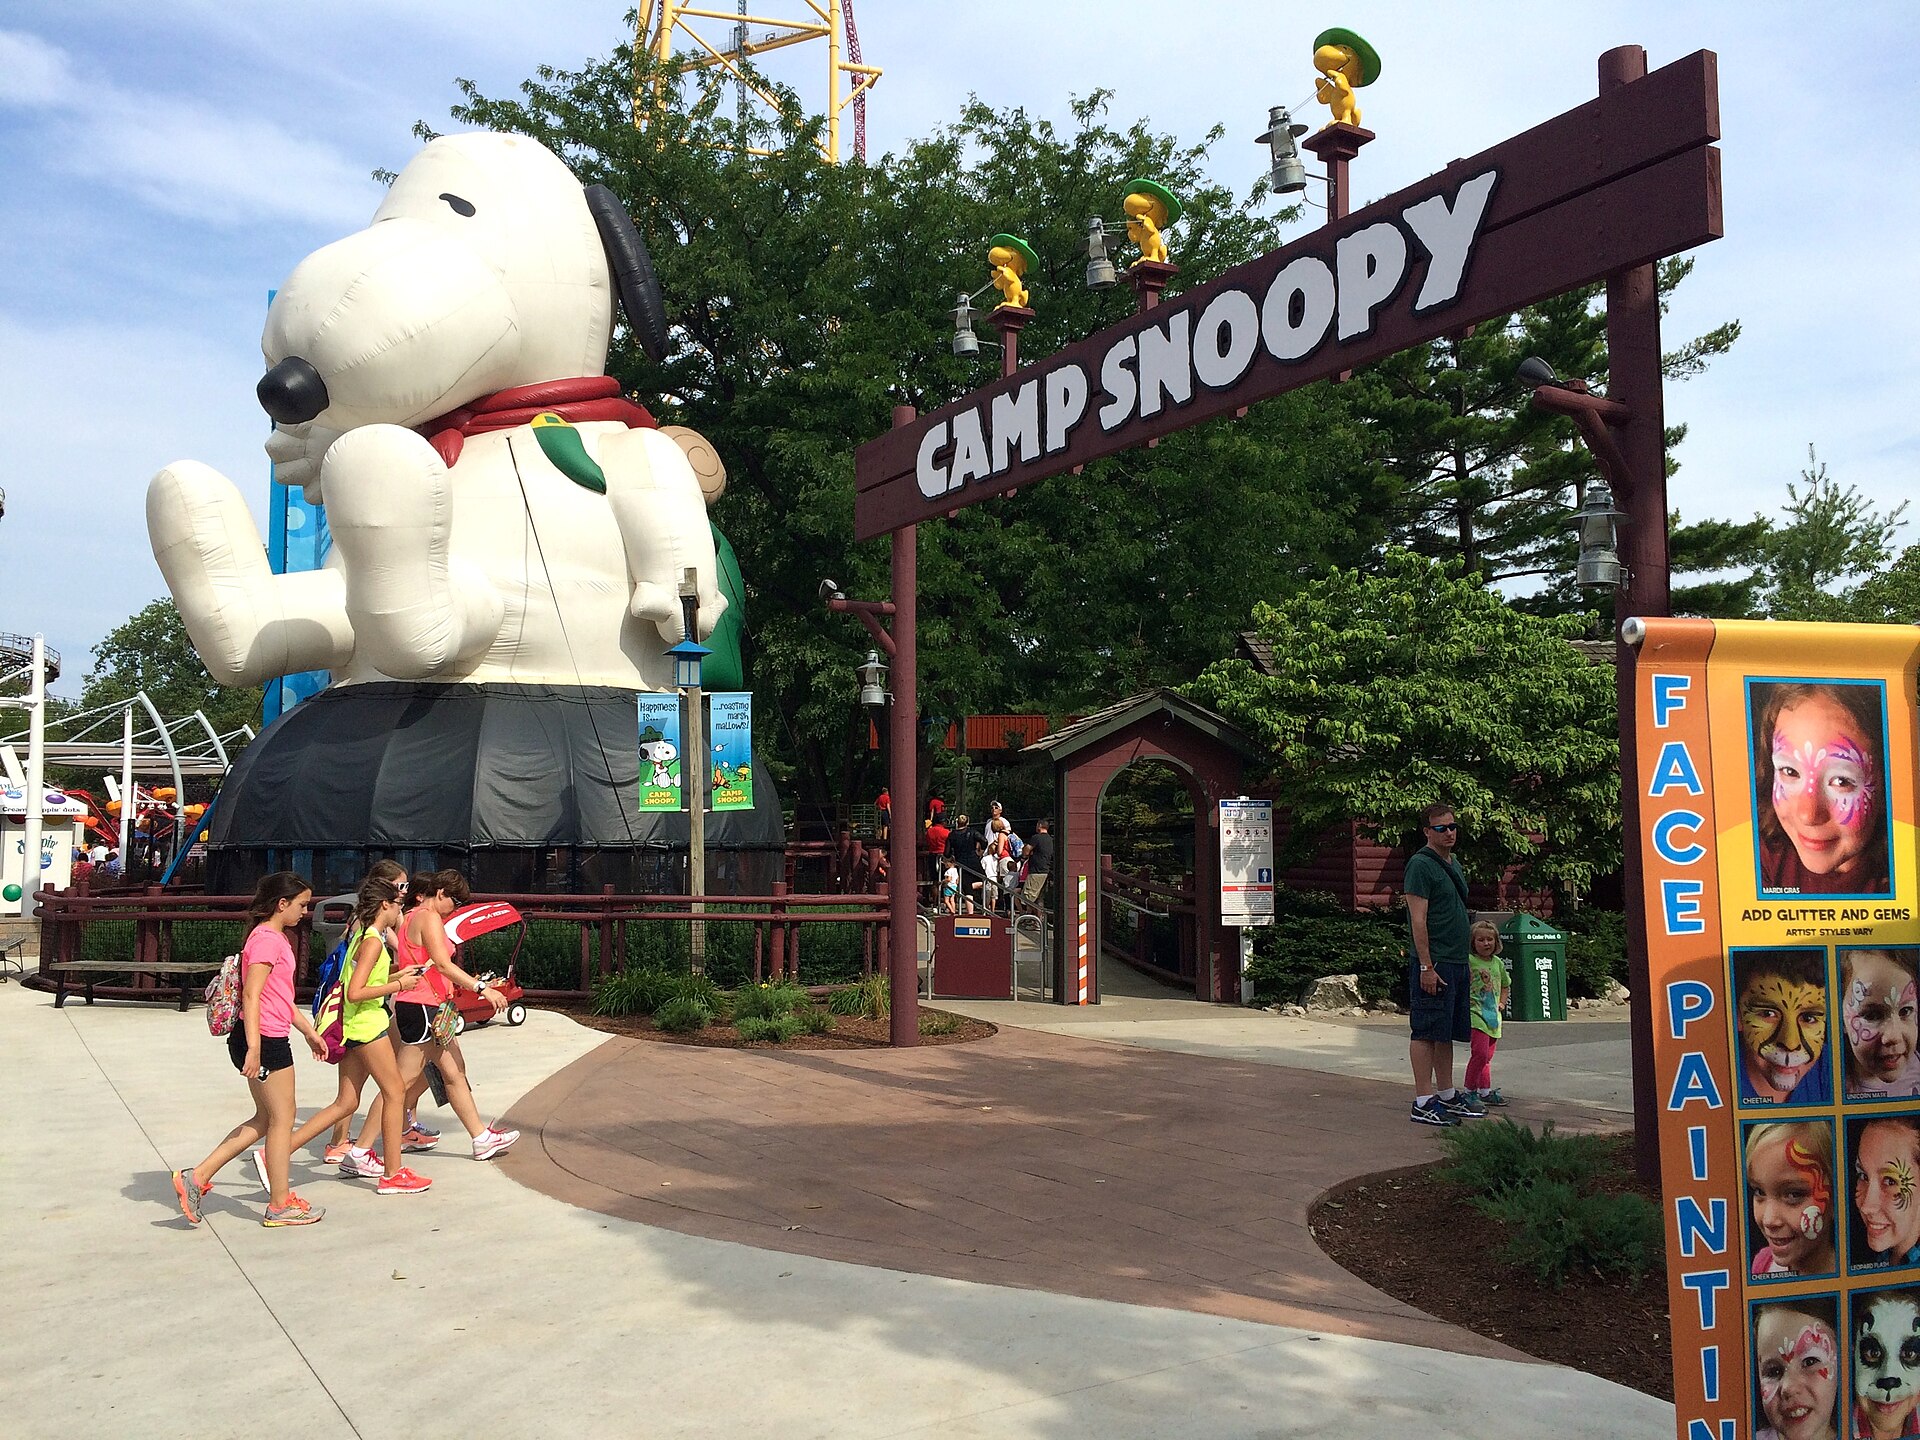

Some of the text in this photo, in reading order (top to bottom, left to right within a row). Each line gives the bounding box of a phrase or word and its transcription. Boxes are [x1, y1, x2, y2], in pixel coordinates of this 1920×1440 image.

[916, 170, 1497, 499] CAMP SNOOPY
[640, 703, 677, 713] Happiness
[714, 702, 749, 711] ...roasting
[643, 713, 659, 721] is...
[727, 712, 749, 720] marsh
[645, 797, 676, 805] SNOOPY
[1648, 674, 1707, 936] FACE
[1741, 908, 1911, 921] ADD GLITTER AND GEMS
[1786, 928, 1873, 936] ARTIST STYLES VARY
[1540, 971, 1551, 1019] RECYCLE
[1742, 1097, 1772, 1105] CHEETAH
[1851, 1262, 1874, 1271] LEOPARD
[1771, 1271, 1798, 1279] BASEBALL
